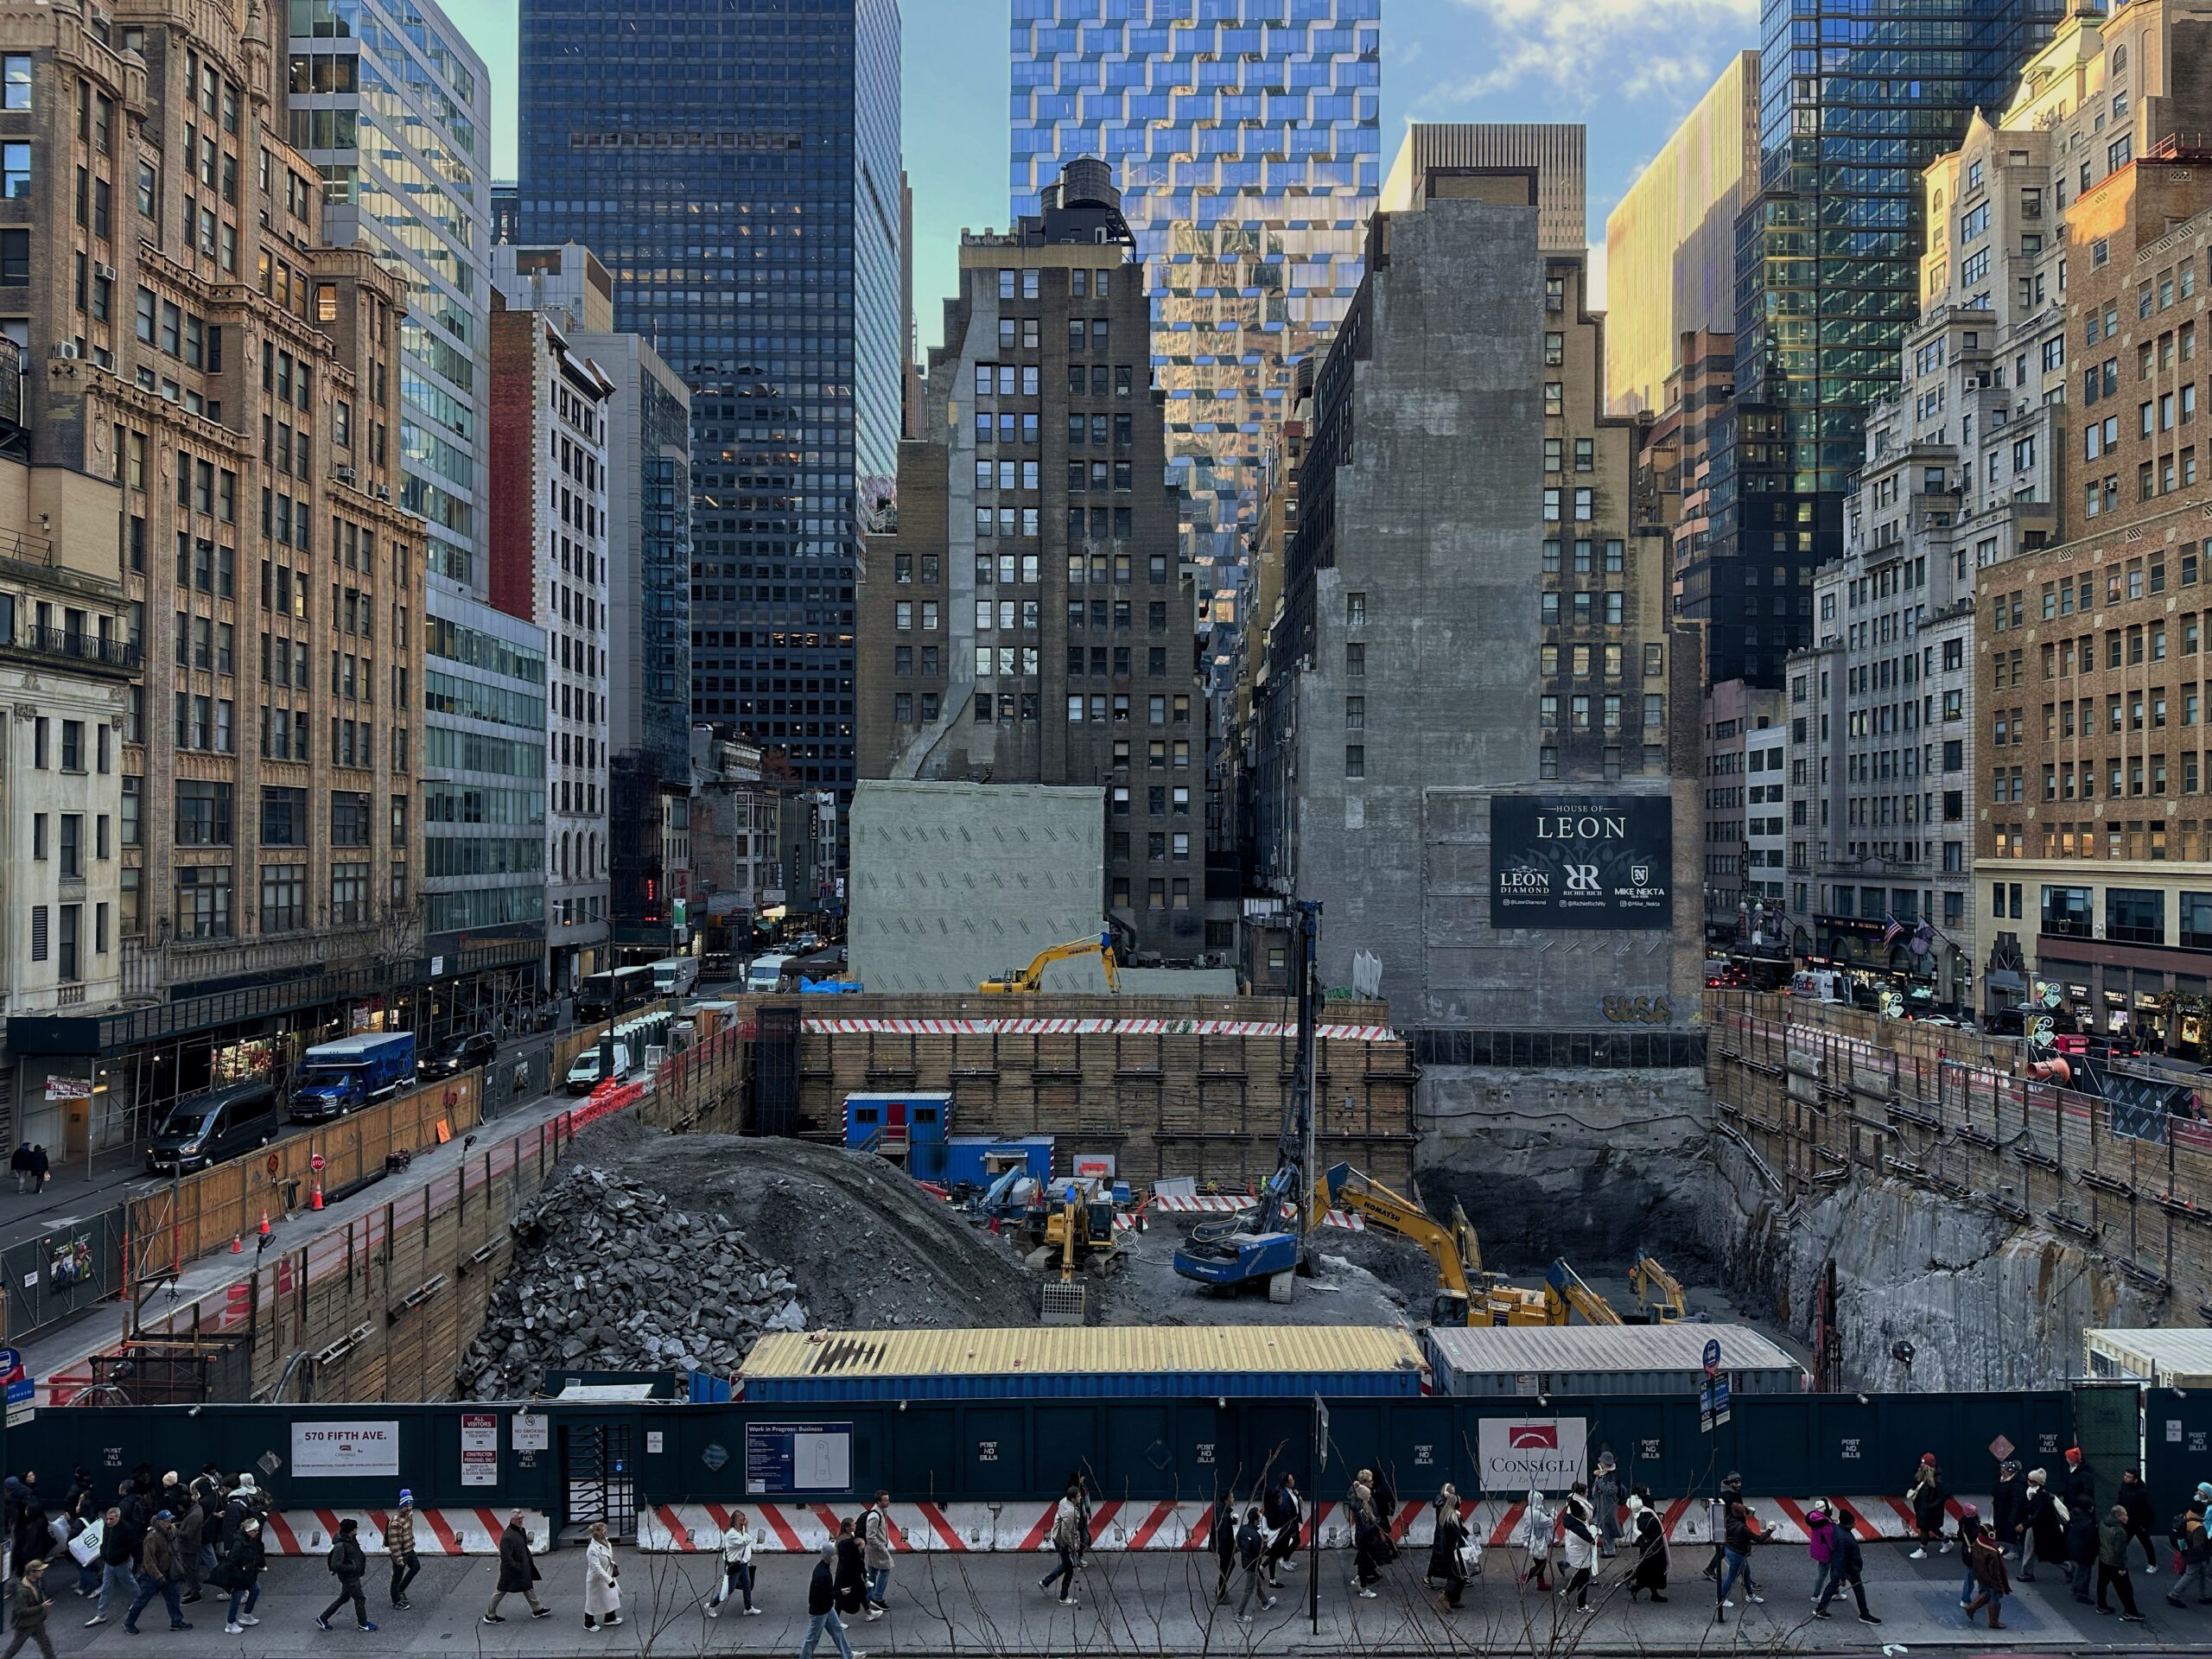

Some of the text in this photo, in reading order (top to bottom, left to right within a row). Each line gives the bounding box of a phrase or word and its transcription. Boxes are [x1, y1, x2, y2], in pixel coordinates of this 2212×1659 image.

[1536, 817, 1627, 839] LEON
[1500, 873, 1550, 887] LEON
[1363, 1201, 1401, 1222] KOMATSU
[305, 1432, 324, 1440] 570
[327, 1432, 359, 1440] FIFTH
[1491, 1457, 1575, 1472] CONSIGLI
